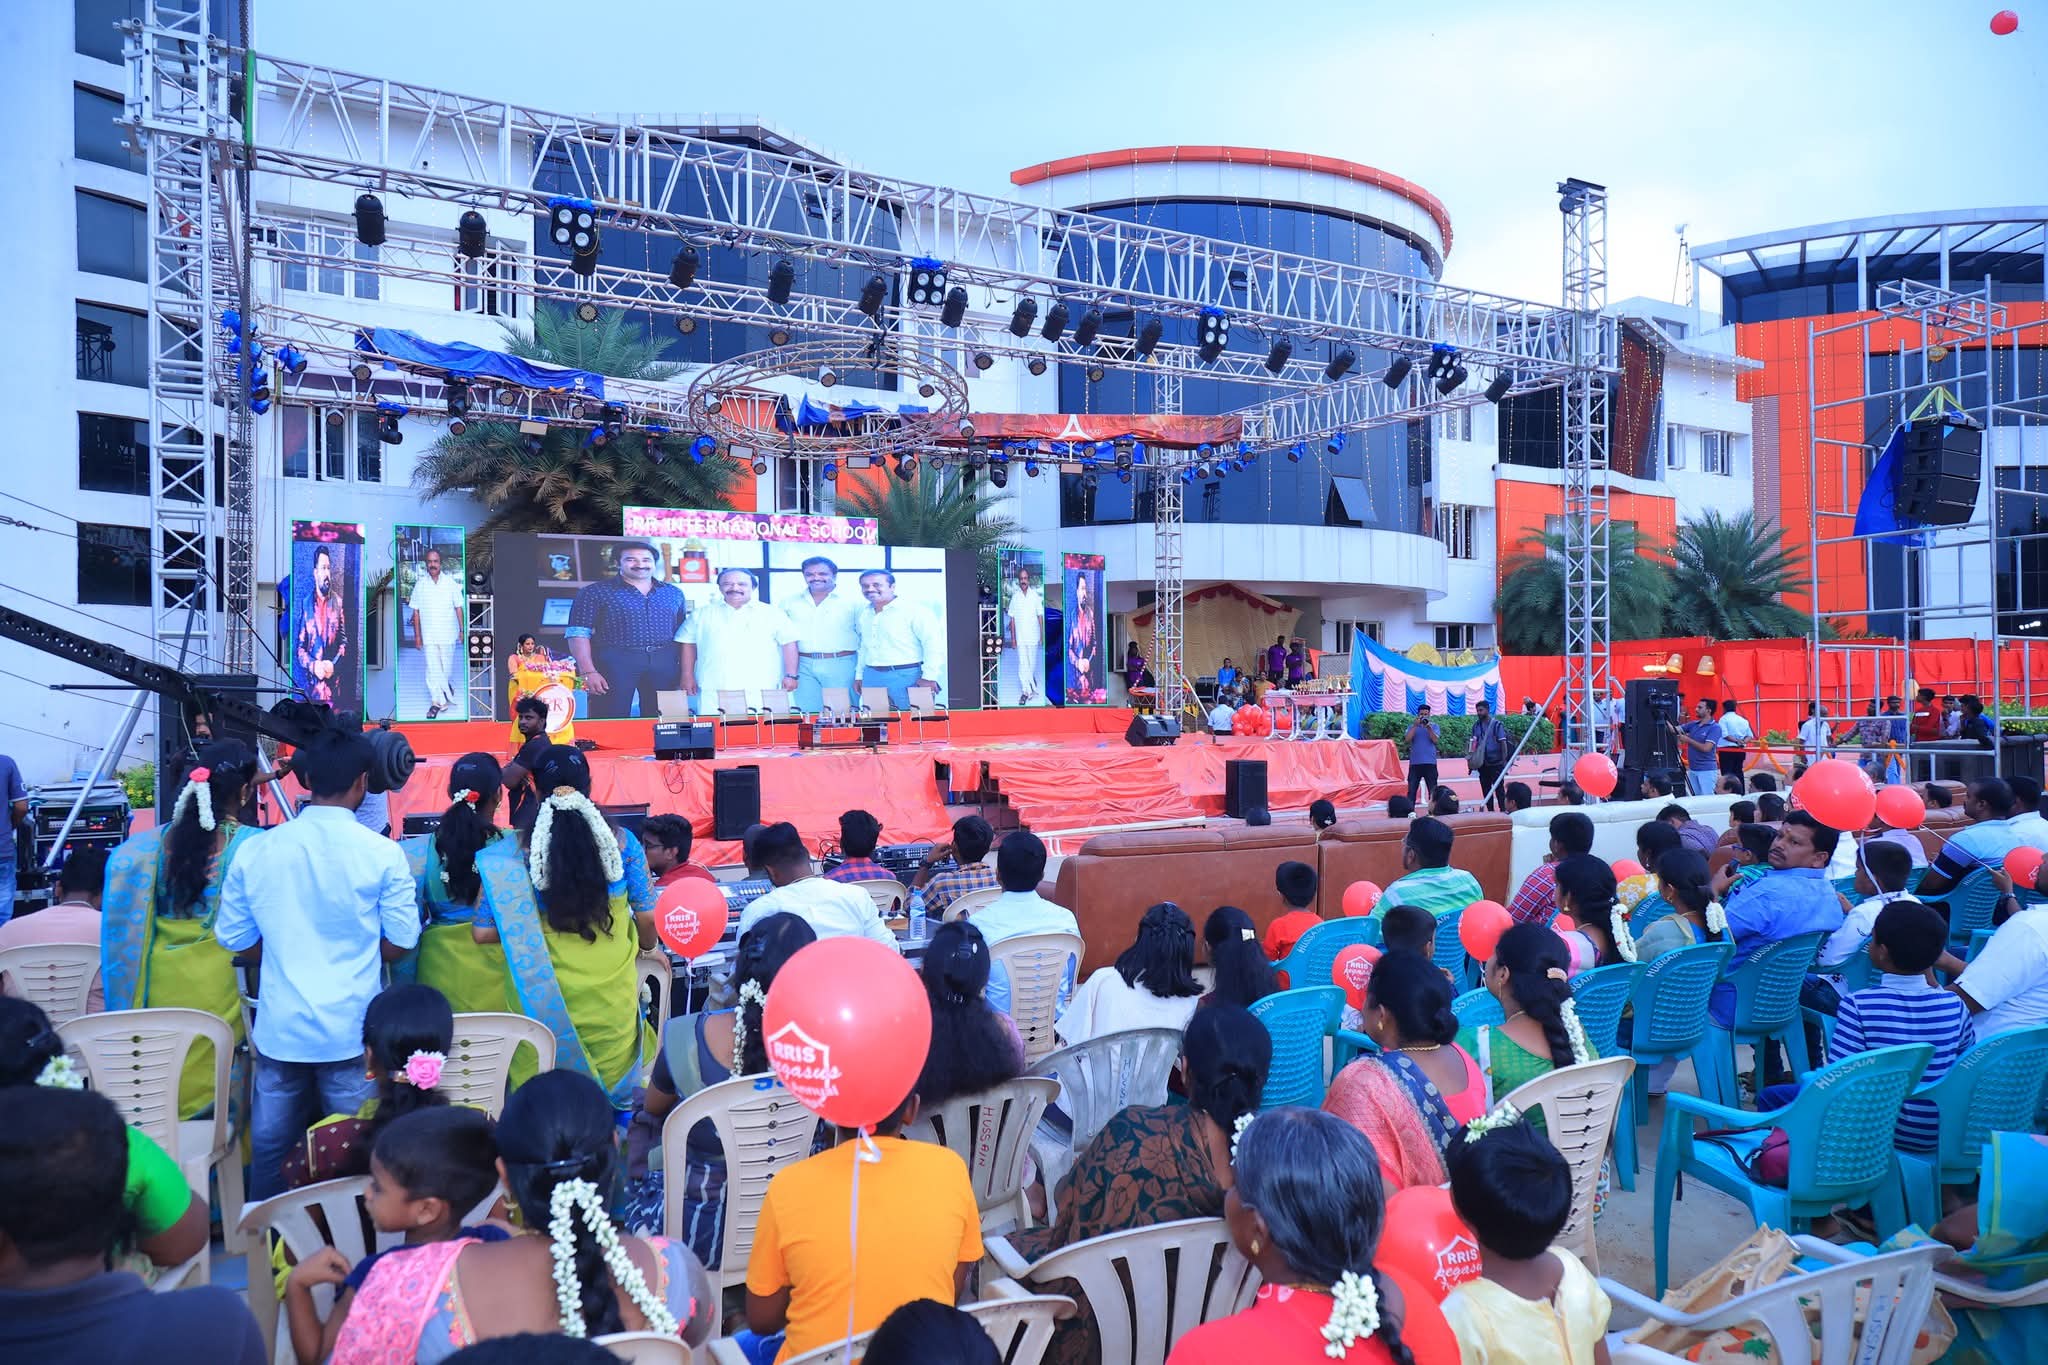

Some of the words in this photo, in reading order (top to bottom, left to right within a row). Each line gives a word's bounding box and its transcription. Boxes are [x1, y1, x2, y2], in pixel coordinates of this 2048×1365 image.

[665, 517, 801, 537] INTERNATIONAL
[809, 523, 877, 543] SCHOOL
[670, 914, 691, 922] RRIS
[773, 1041, 817, 1064] RRIS
[1815, 1056, 1877, 1090] HUSSAIN
[1447, 1248, 1478, 1265] RRIS
